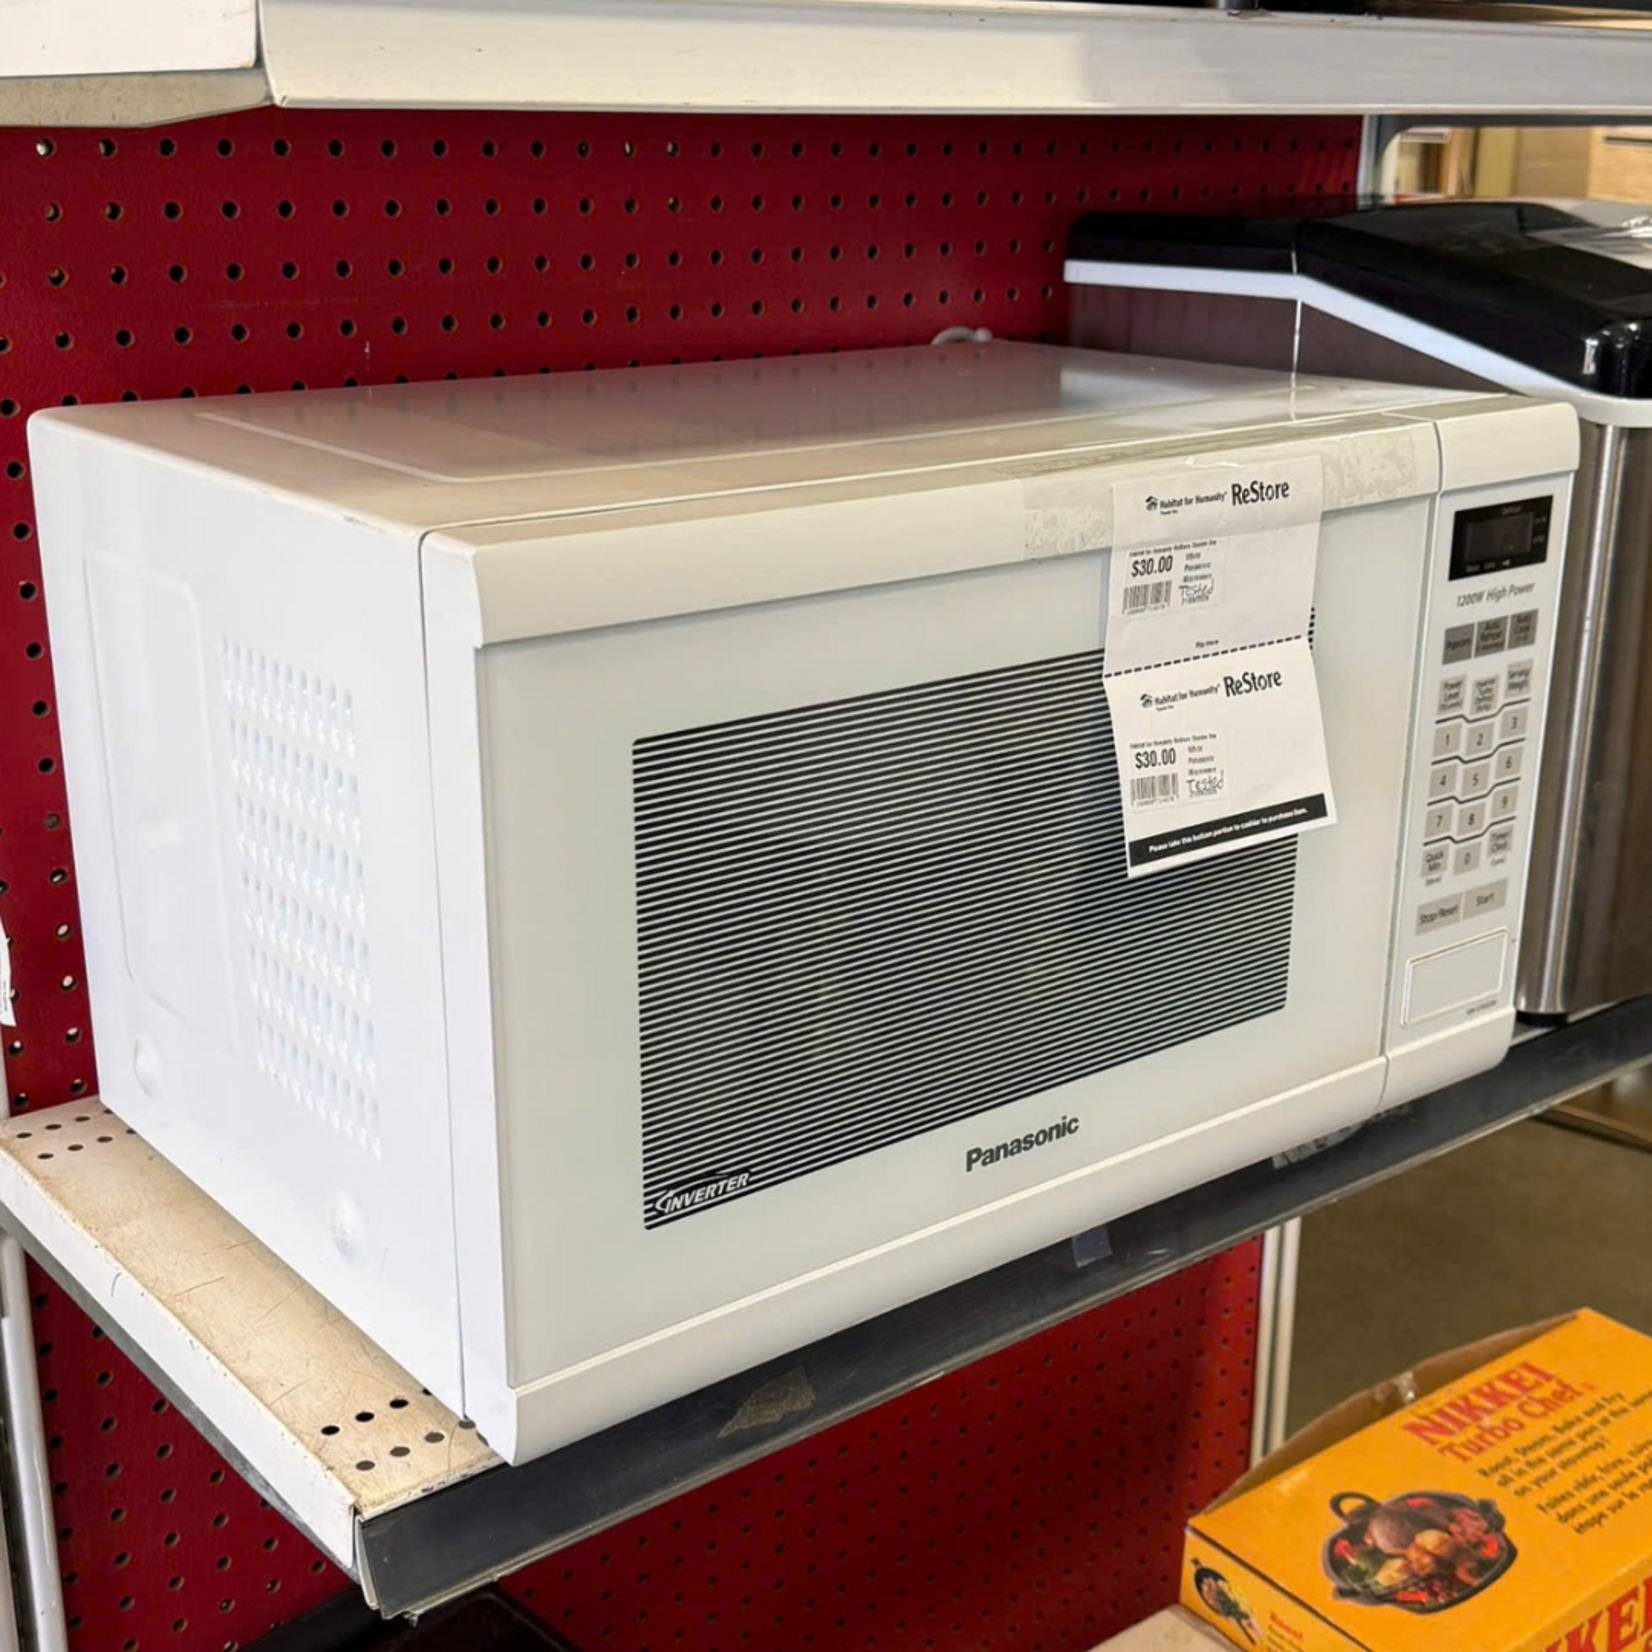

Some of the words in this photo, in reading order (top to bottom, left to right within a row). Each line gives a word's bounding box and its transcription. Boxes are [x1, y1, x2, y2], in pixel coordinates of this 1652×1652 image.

[1160, 498, 1183, 509] Habitat
[1184, 496, 1193, 505] for
[1231, 480, 1290, 506] ReStore
[1131, 555, 1173, 577] $30.00
[1457, 590, 1486, 607] 1200W
[1486, 586, 1507, 603] High
[1508, 583, 1536, 597] Power
[1155, 694, 1178, 705] Habitat
[1179, 691, 1188, 700] for
[1223, 671, 1283, 697] ReStore
[1511, 716, 1518, 730] 3
[1445, 733, 1450, 746] 1
[1476, 733, 1484, 746] 2
[1135, 748, 1176, 769] $30.00
[1506, 755, 1513, 769] 6
[1440, 774, 1447, 786] 4
[1472, 773, 1479, 786] 5
[1501, 796, 1508, 808] 9
[1436, 814, 1443, 827] 7
[1468, 813, 1475, 826] 8
[1148, 844, 1168, 853] Please
[1169, 839, 1180, 847] take
[1181, 836, 1192, 844] this
[1192, 831, 1213, 842] bottom
[1213, 825, 1233, 837] portion
[1241, 819, 1261, 830] cashier
[1464, 852, 1471, 865] 0
[1475, 892, 1495, 907] Start
[966, 1114, 1080, 1172] Panasonic
[664, 1171, 751, 1213] INVERTER
[1402, 1361, 1556, 1447] NIKKEI
[1437, 1417, 1526, 1464] Turbo
[1517, 1378, 1584, 1420] Chef
